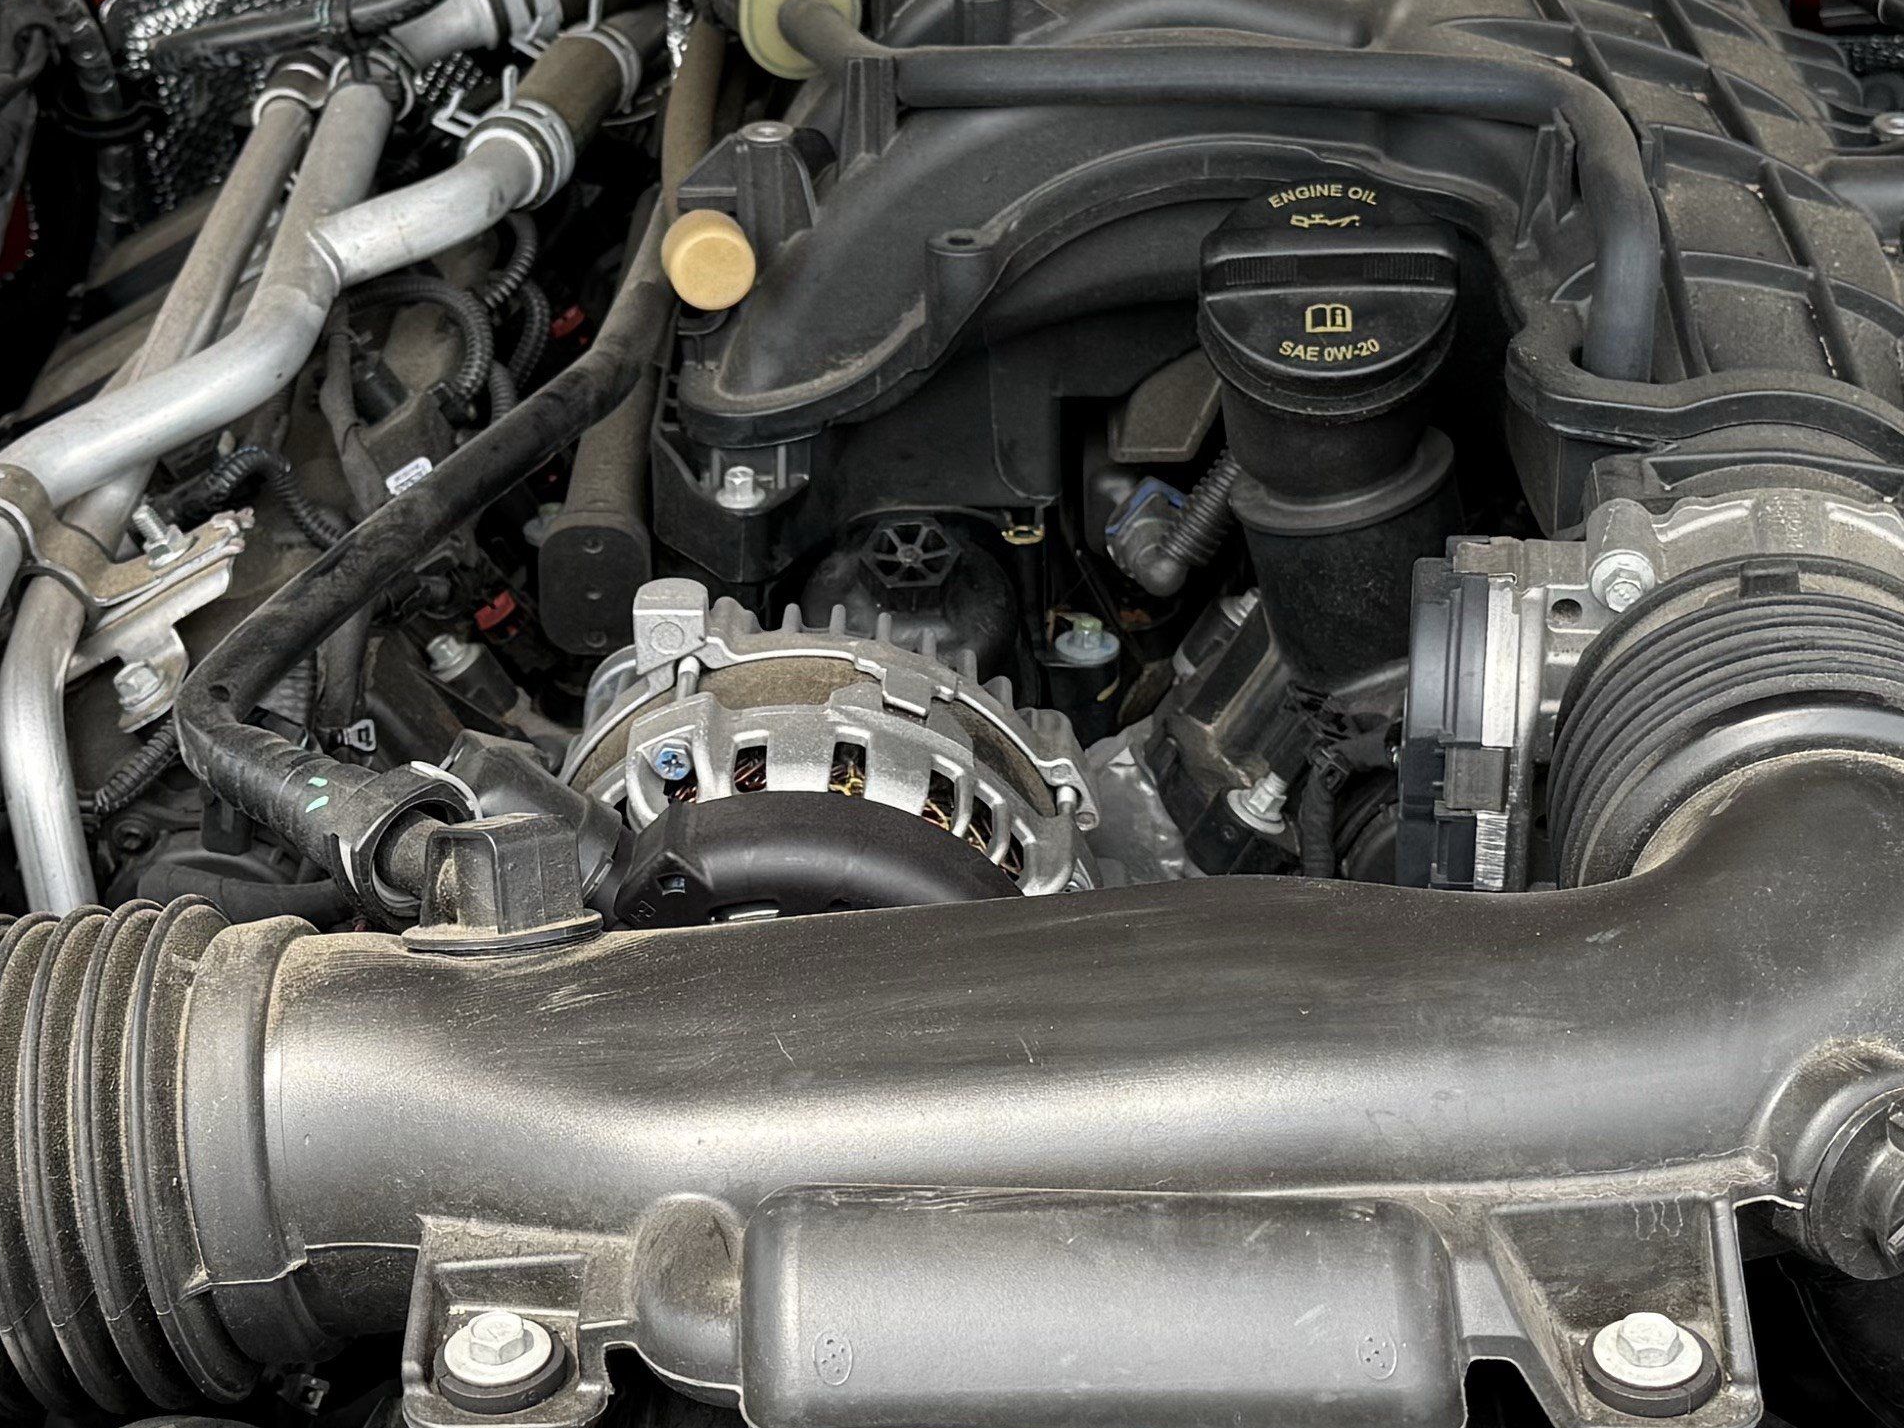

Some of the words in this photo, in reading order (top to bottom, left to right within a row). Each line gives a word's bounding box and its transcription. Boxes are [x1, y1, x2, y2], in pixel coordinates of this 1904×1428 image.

[1267, 184, 1343, 208] ENGINE
[1348, 187, 1377, 205] OIL
[1279, 341, 1319, 361] SAE
[1324, 338, 1380, 361] 0W-20
